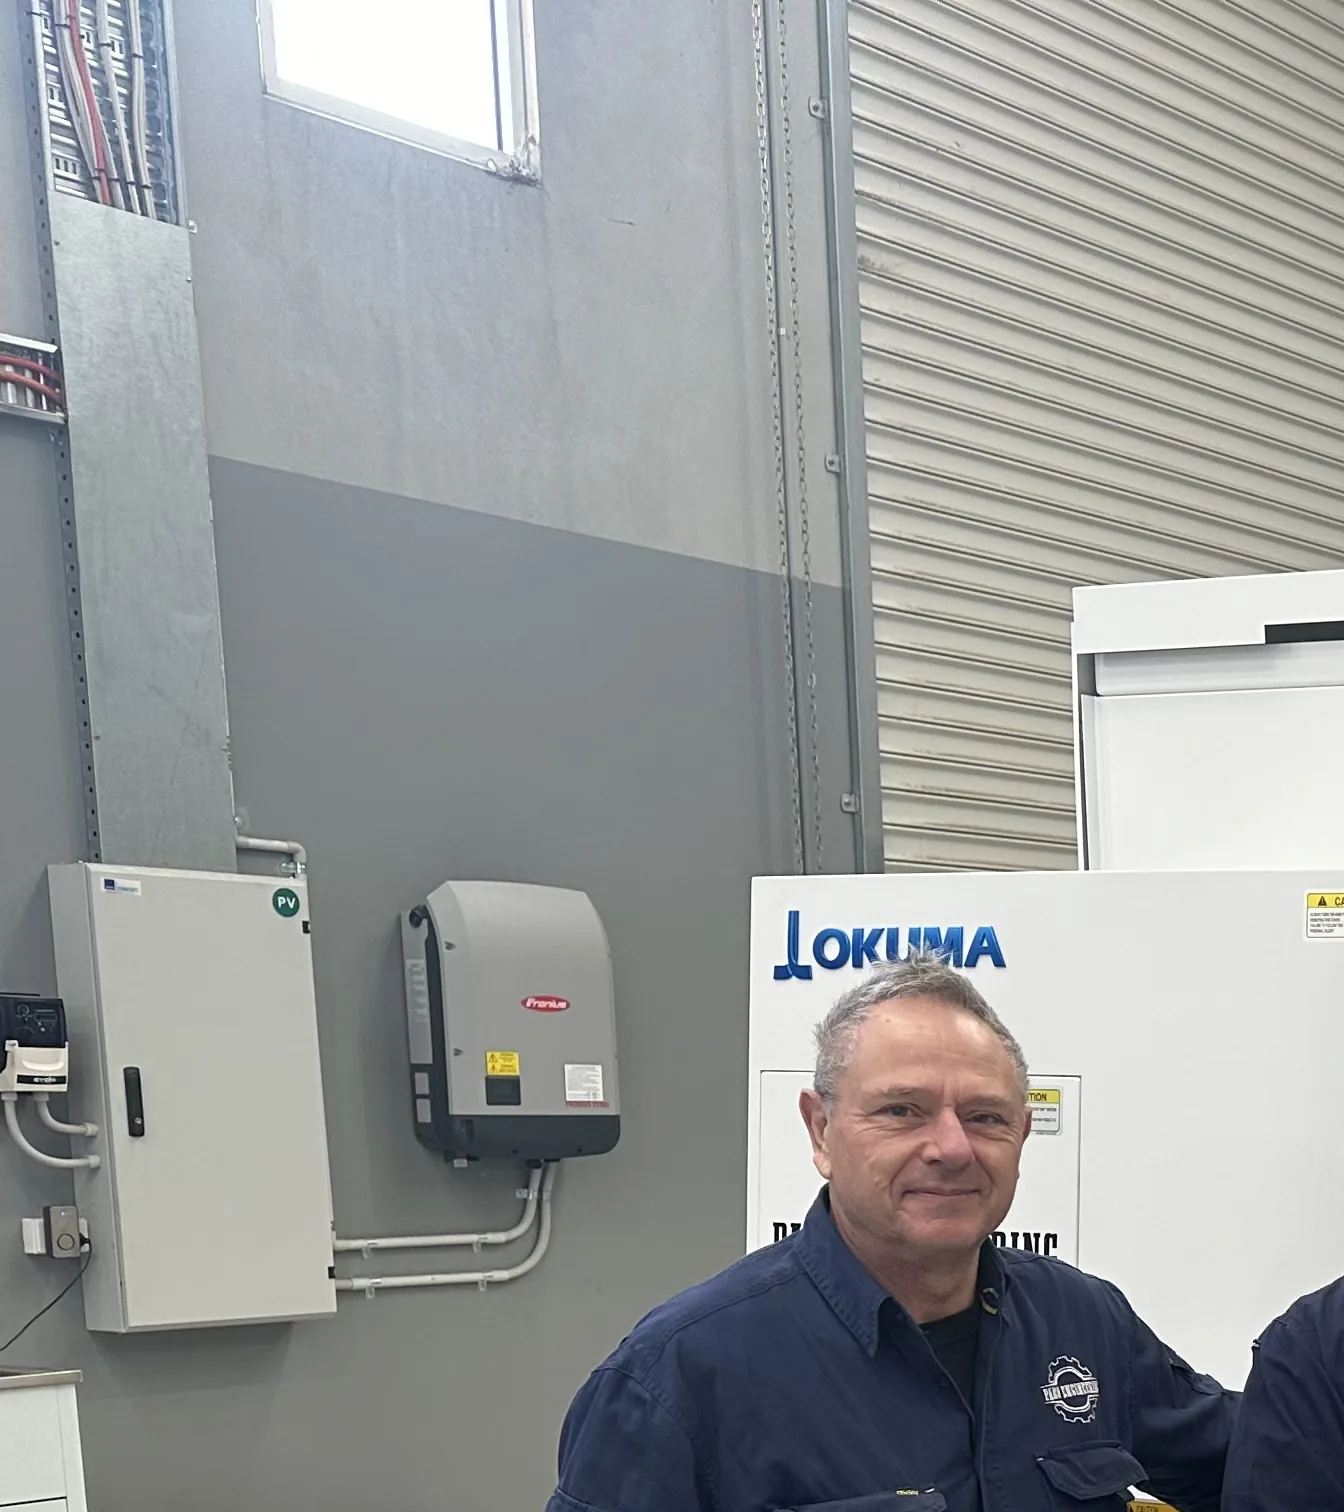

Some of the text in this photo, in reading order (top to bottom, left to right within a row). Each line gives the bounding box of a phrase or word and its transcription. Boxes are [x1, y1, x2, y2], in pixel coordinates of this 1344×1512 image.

[277, 896, 295, 909] PV
[812, 926, 1007, 970] OKUMA
[1029, 1092, 1048, 1102] TION
